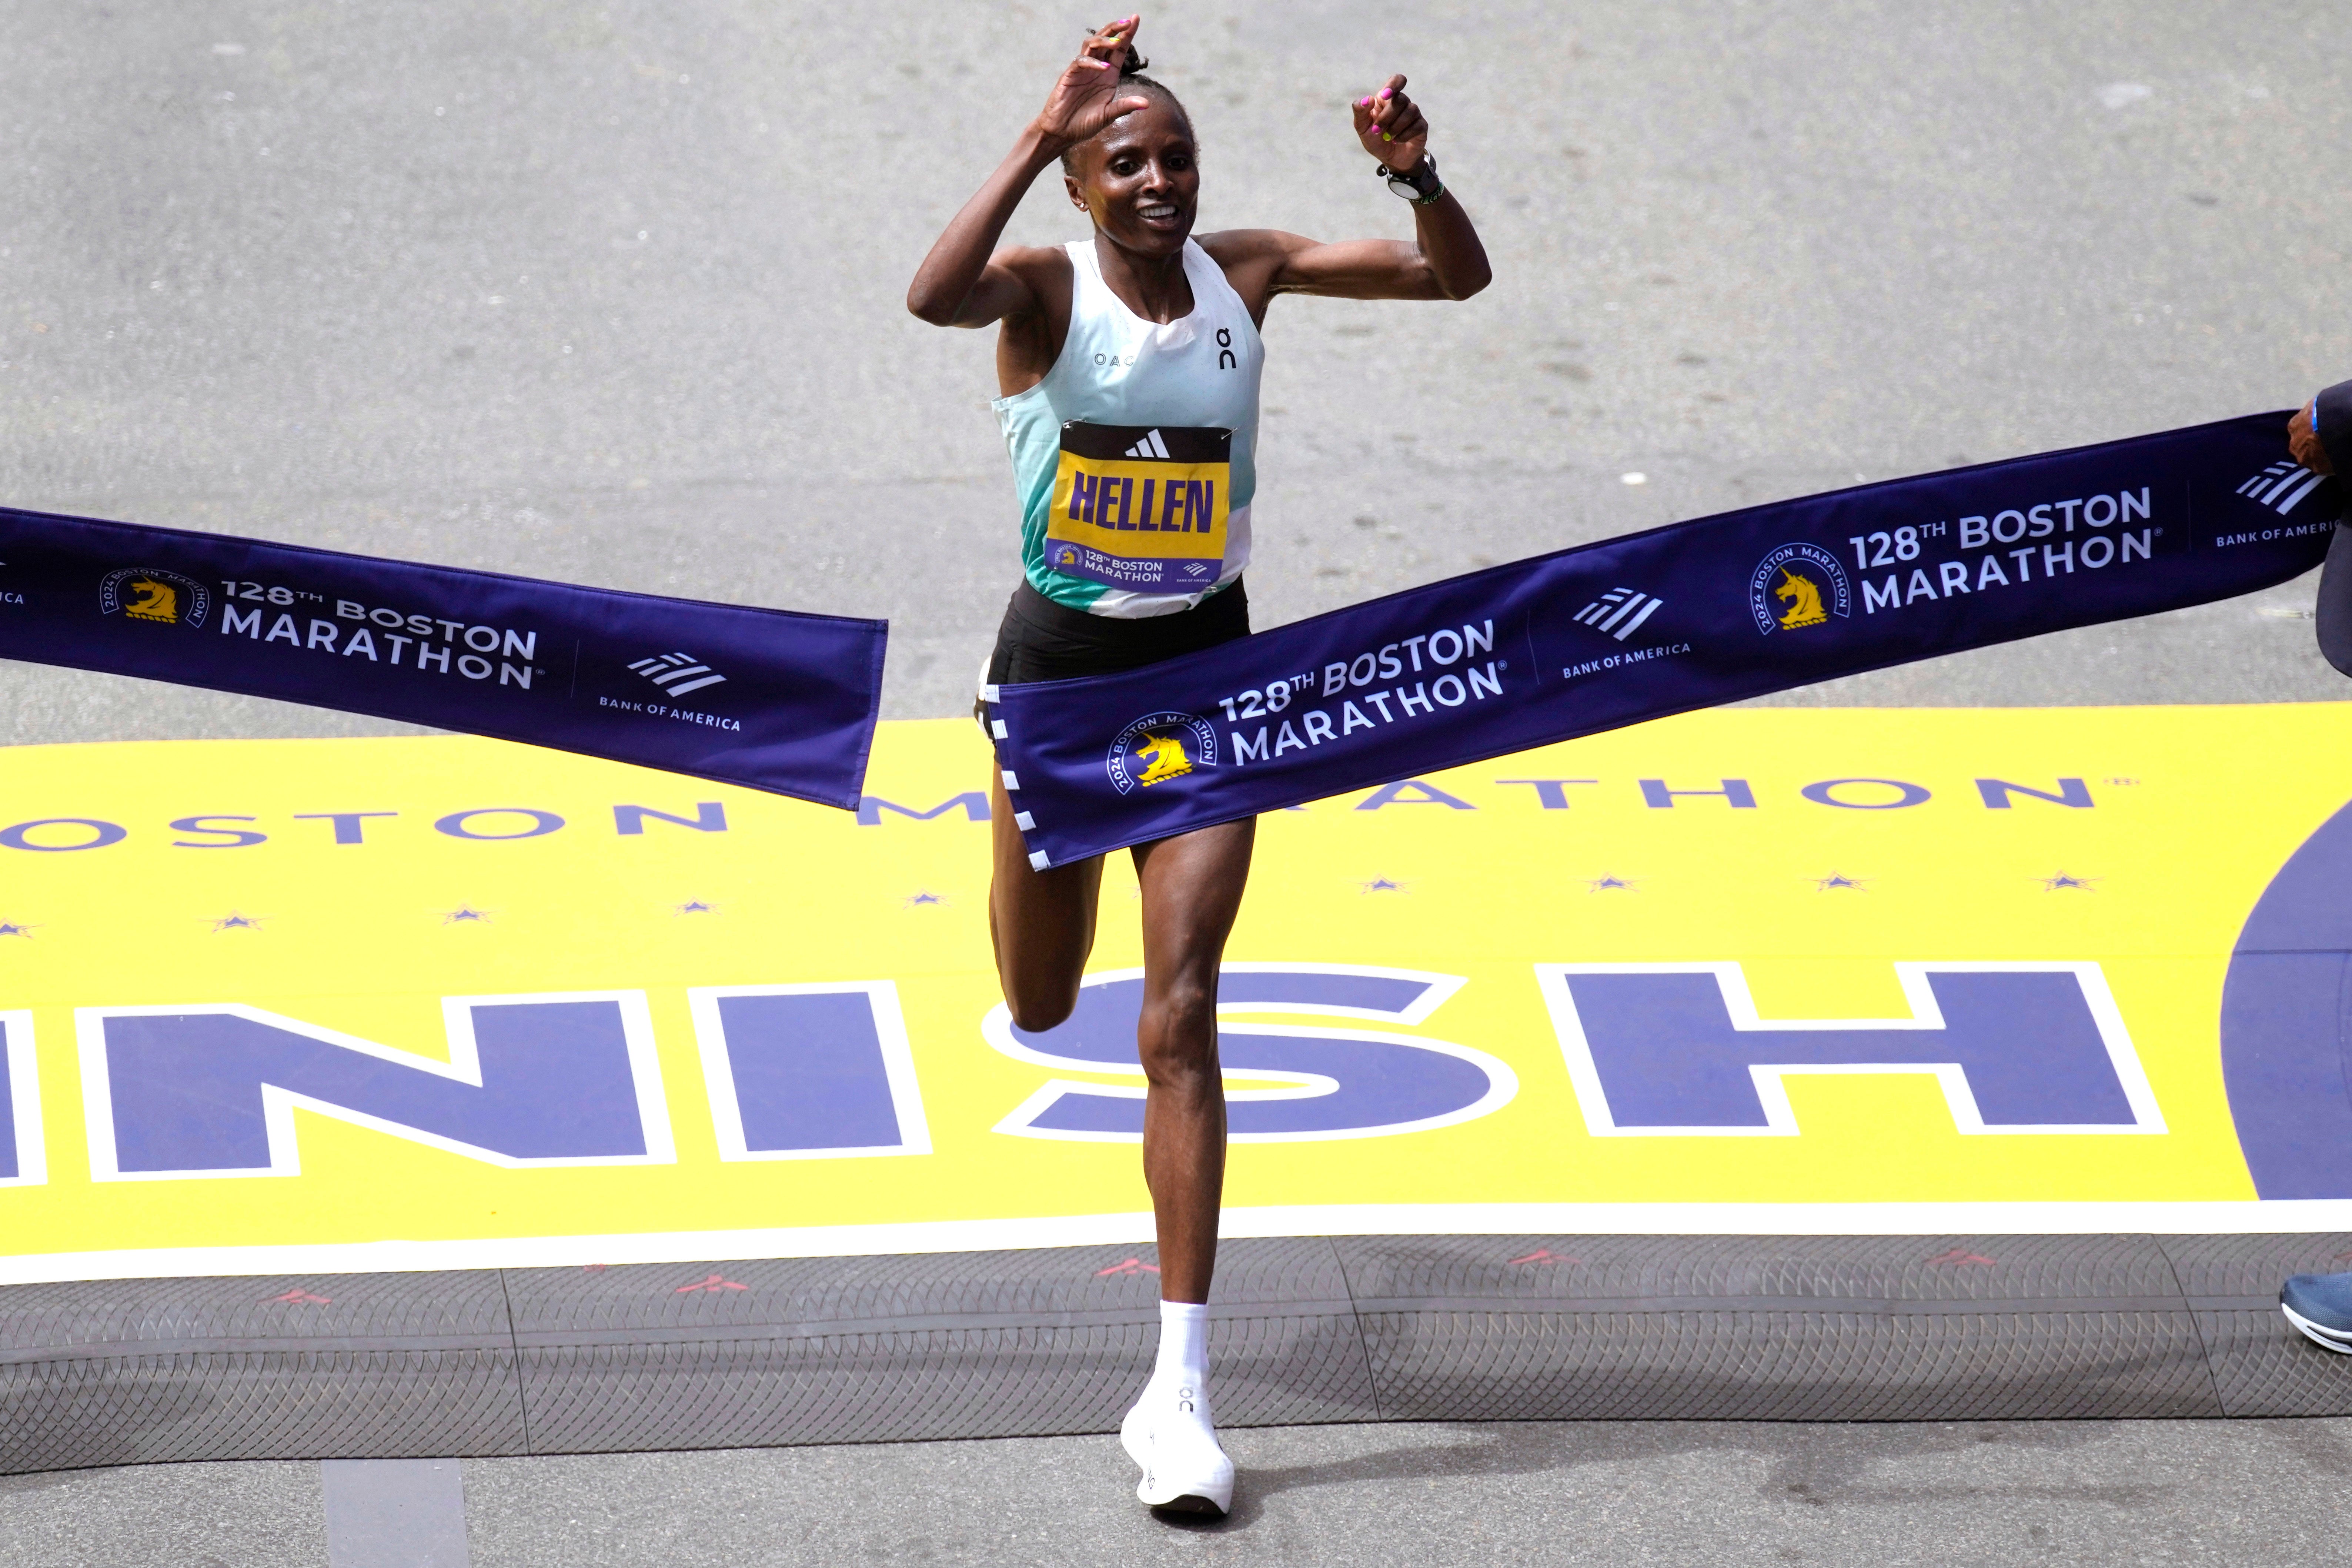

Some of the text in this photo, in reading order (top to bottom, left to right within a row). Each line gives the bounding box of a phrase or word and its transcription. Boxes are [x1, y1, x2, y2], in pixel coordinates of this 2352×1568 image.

[1095, 353, 1134, 367] OAC
[1069, 471, 1213, 533] HELLEN
[1850, 487, 2150, 570] 128TH BOSTON
[2216, 519, 2341, 547] BANK OF AMERIC
[104, 569, 206, 618] 2024 BOSTON MARATHON
[1085, 550, 1162, 571] 128TH BOSTON
[1754, 547, 1847, 627] 2024 BOSTON MARATHON
[222, 581, 536, 660] 128TH BOSTON
[1219, 619, 1493, 722] 128TH BOSTON
[1563, 643, 1690, 679] BANK OF AMERICA
[600, 697, 740, 732] BANK OF AMERICA
[1111, 715, 1213, 788] 2024 BOSTON MARATHON
[0, 778, 2095, 852] OSTON MATHON
[0, 960, 2170, 1187] NISH
